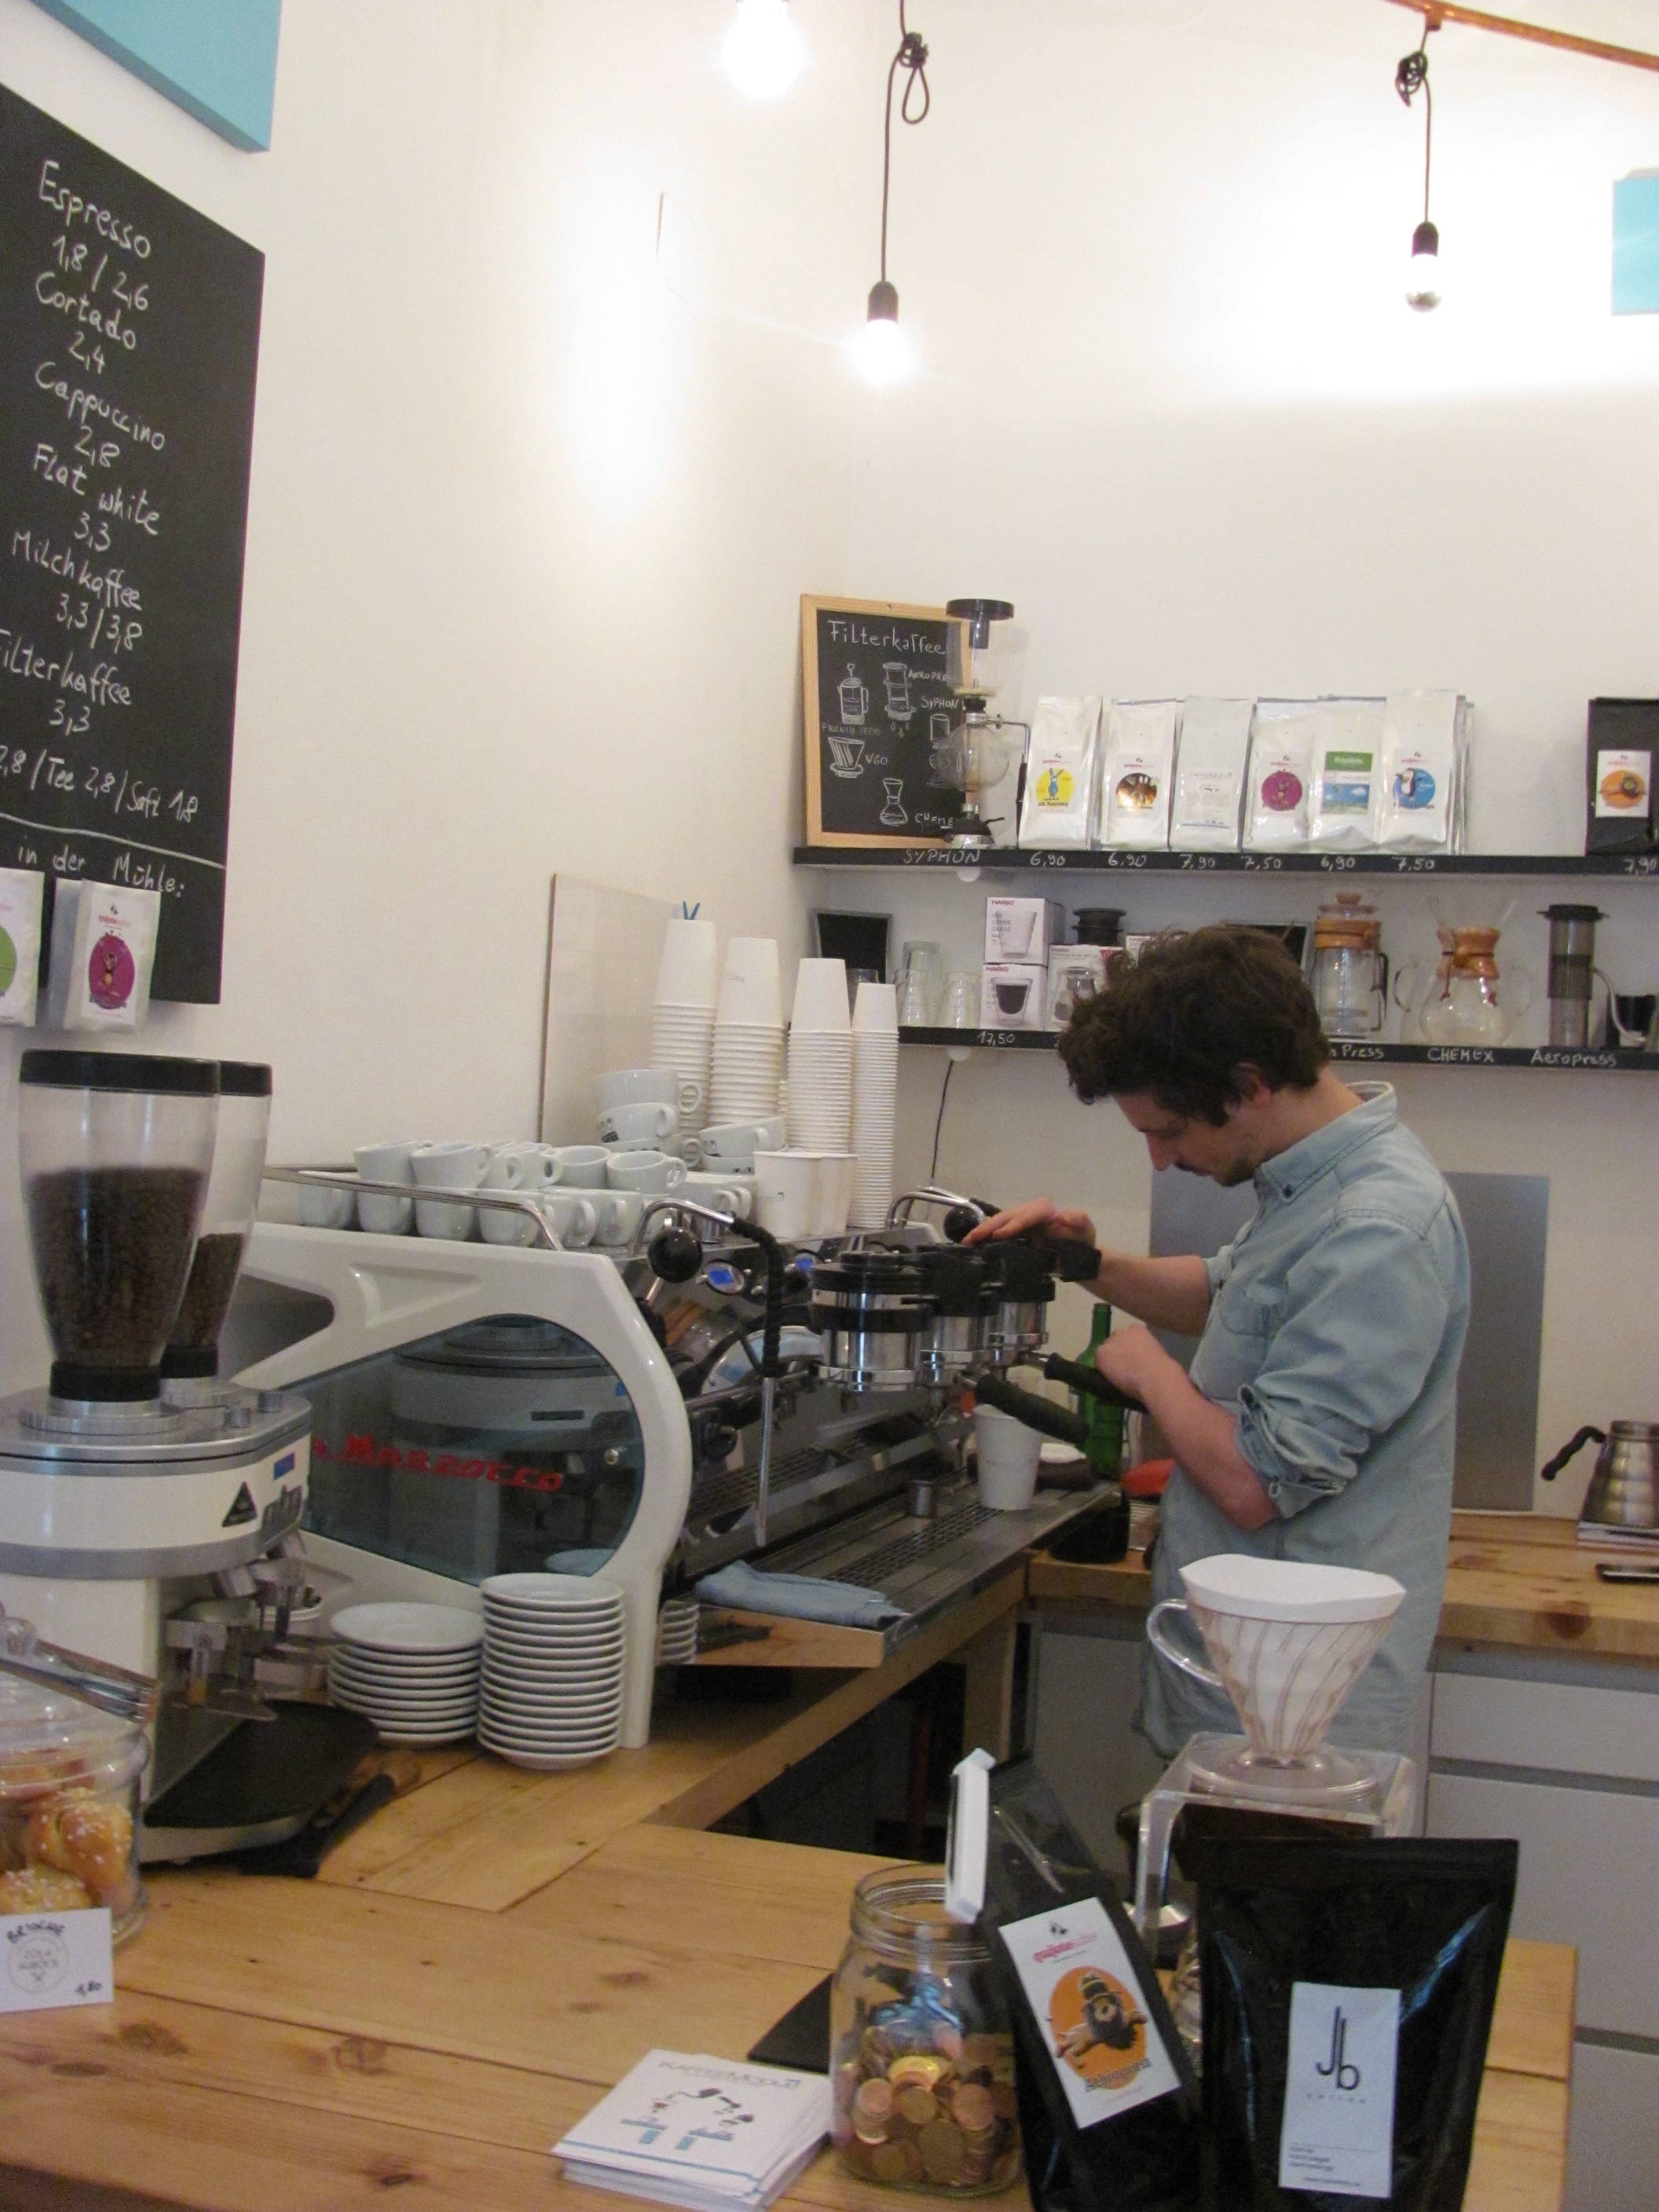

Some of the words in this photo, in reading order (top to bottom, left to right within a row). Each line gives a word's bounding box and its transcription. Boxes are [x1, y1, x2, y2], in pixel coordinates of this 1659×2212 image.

[40, 159, 151, 258] Espresso
[36, 271, 137, 350] Cortado
[69, 330, 106, 375] 2,4
[35, 361, 166, 451] Cappuccino
[74, 425, 120, 468] 2,8
[33, 443, 87, 496] Flat
[98, 487, 160, 536] white
[74, 511, 111, 551] 3,3
[12, 529, 143, 611] Milchkaffee
[827, 620, 947, 655] Filterkaffee
[49, 699, 91, 736] 3,3
[167, 789, 200, 824] 1,8
[17, 836, 38, 865] in
[52, 843, 86, 872] der
[903, 848, 981, 864] SYPHON
[1030, 851, 1067, 868] 6,90
[1108, 851, 1147, 868] 6,90
[1241, 855, 1282, 870] 7,50
[1320, 855, 1357, 872] 6,90
[1391, 856, 1436, 872] 7,50
[976, 1030, 1016, 1046] 17,50
[1427, 1047, 1495, 1064] CHEMEX
[1530, 1049, 1618, 1068] Aeropress
